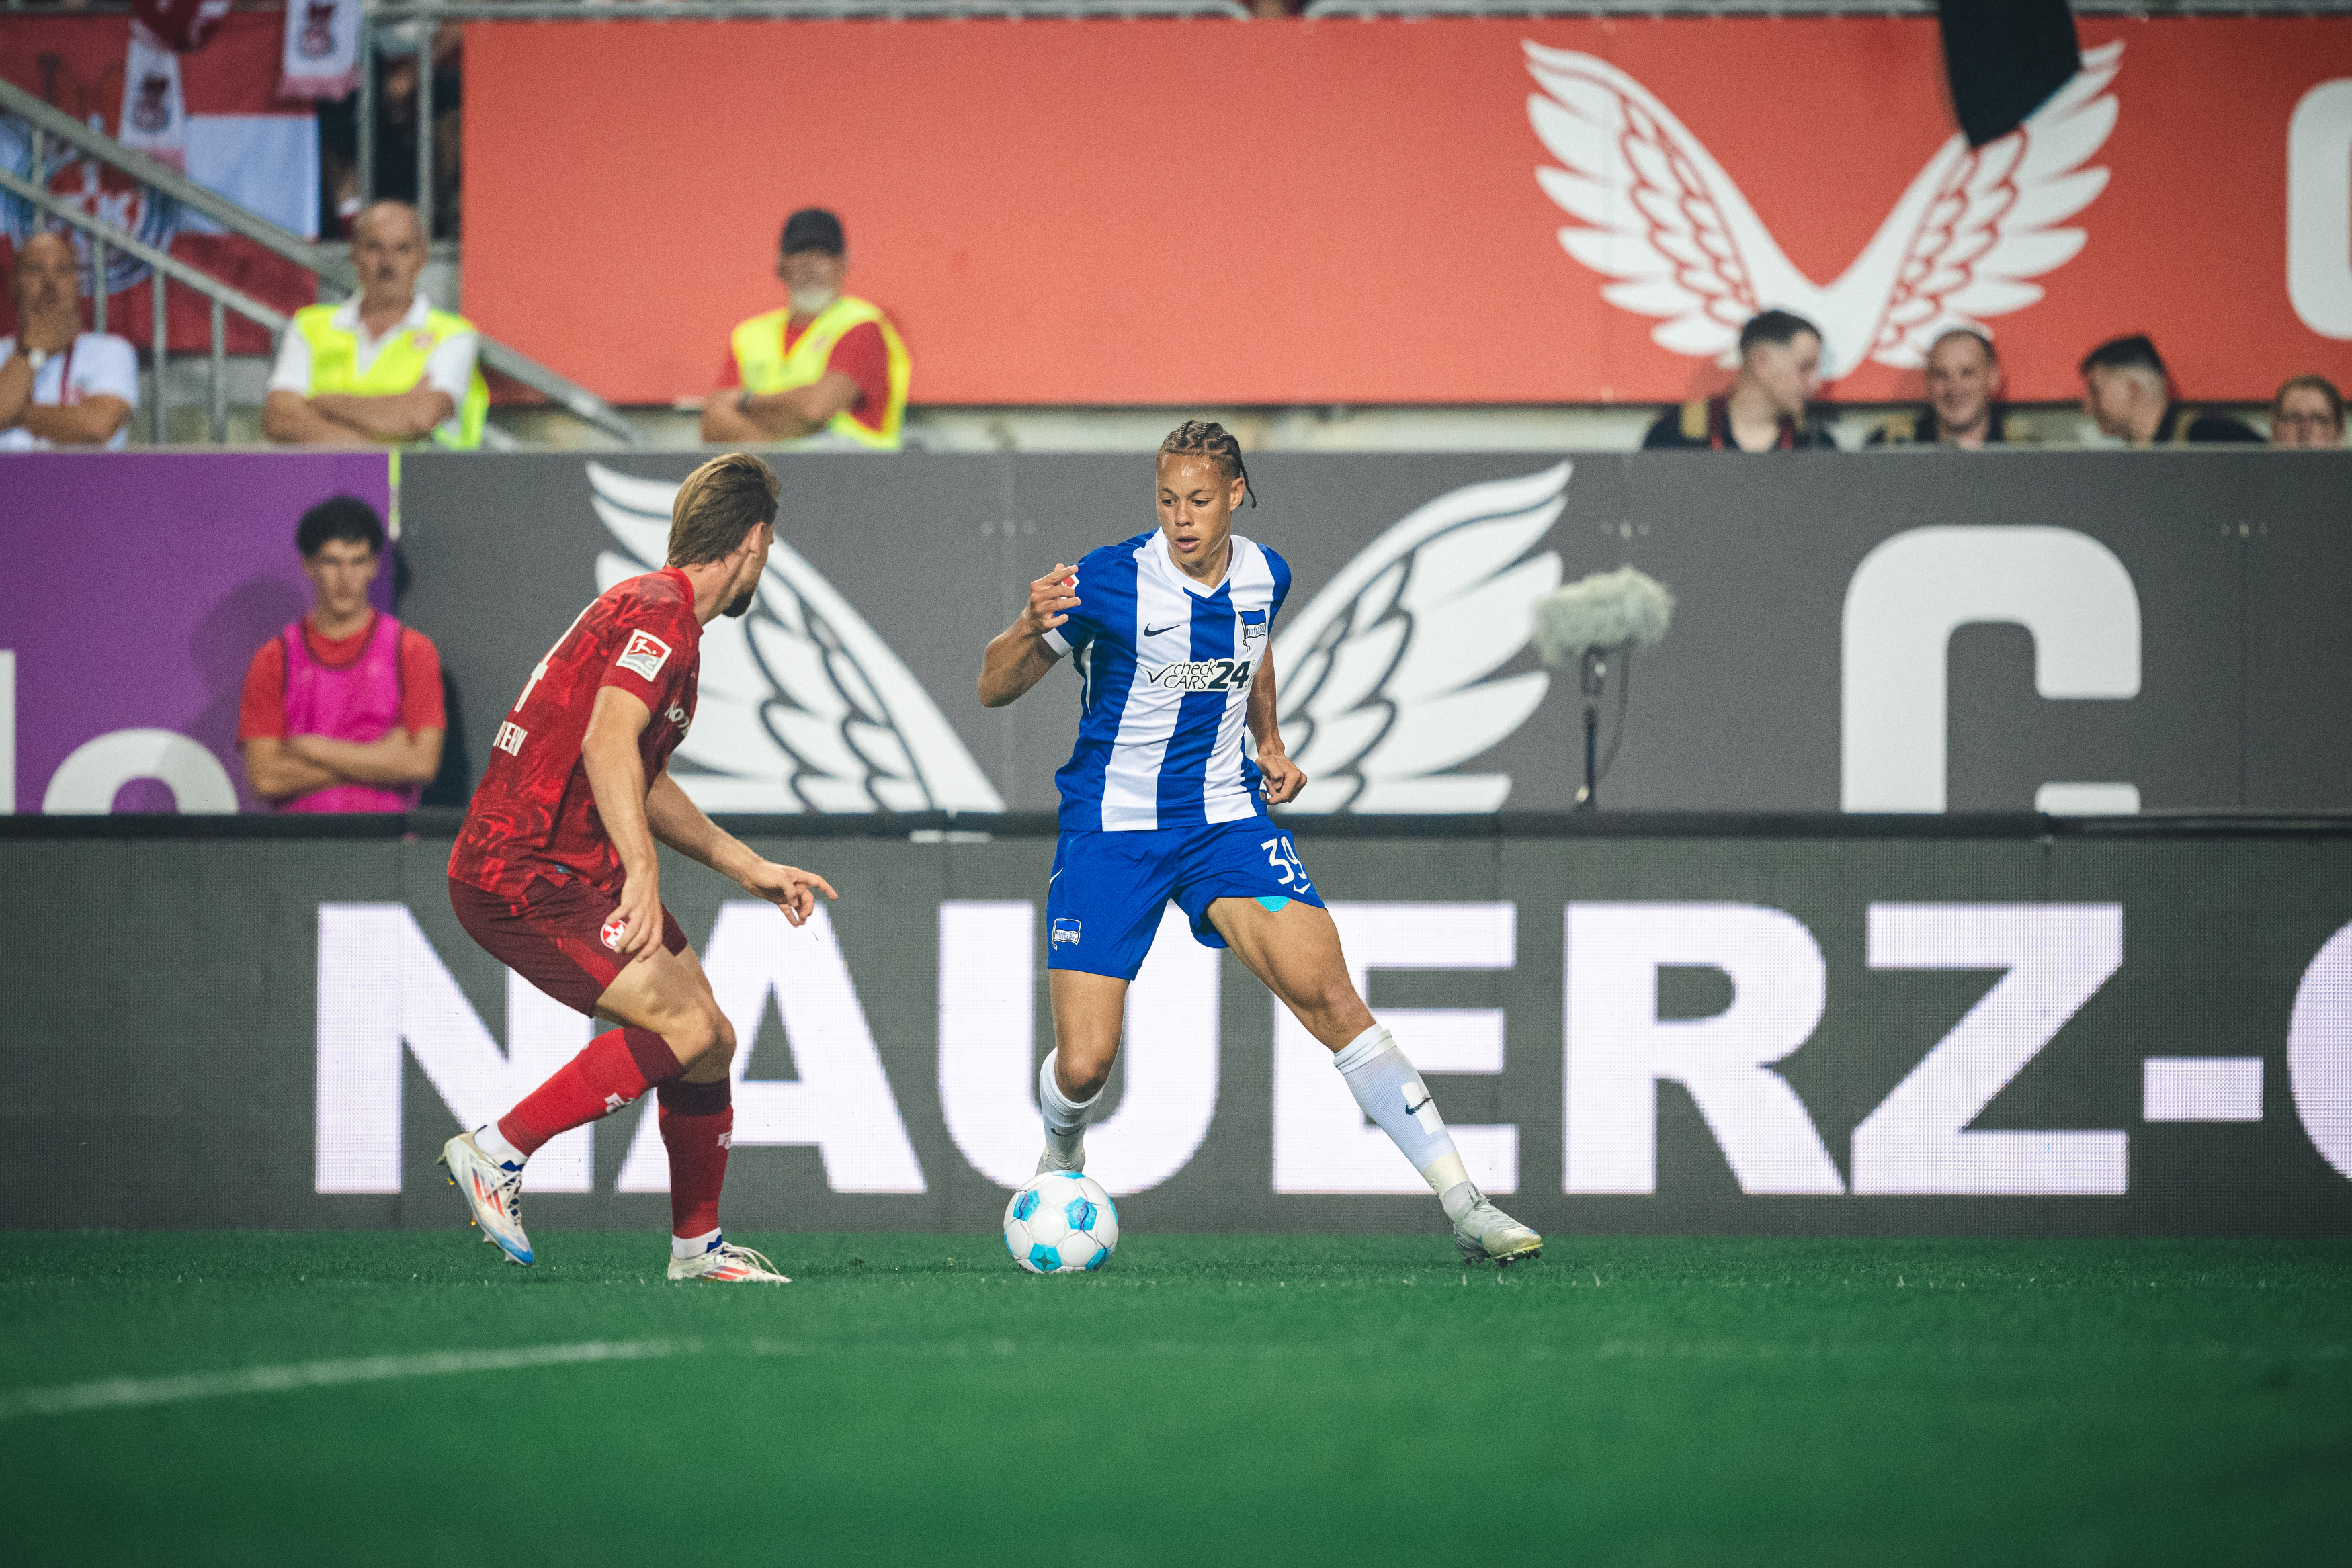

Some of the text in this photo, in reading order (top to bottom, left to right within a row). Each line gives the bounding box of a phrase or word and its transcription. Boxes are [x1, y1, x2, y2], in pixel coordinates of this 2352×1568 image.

[1173, 661, 1216, 675] check
[1163, 675, 1208, 689] CARS
[1261, 836, 1307, 885] 39
[1055, 930, 1069, 940] Hertha
